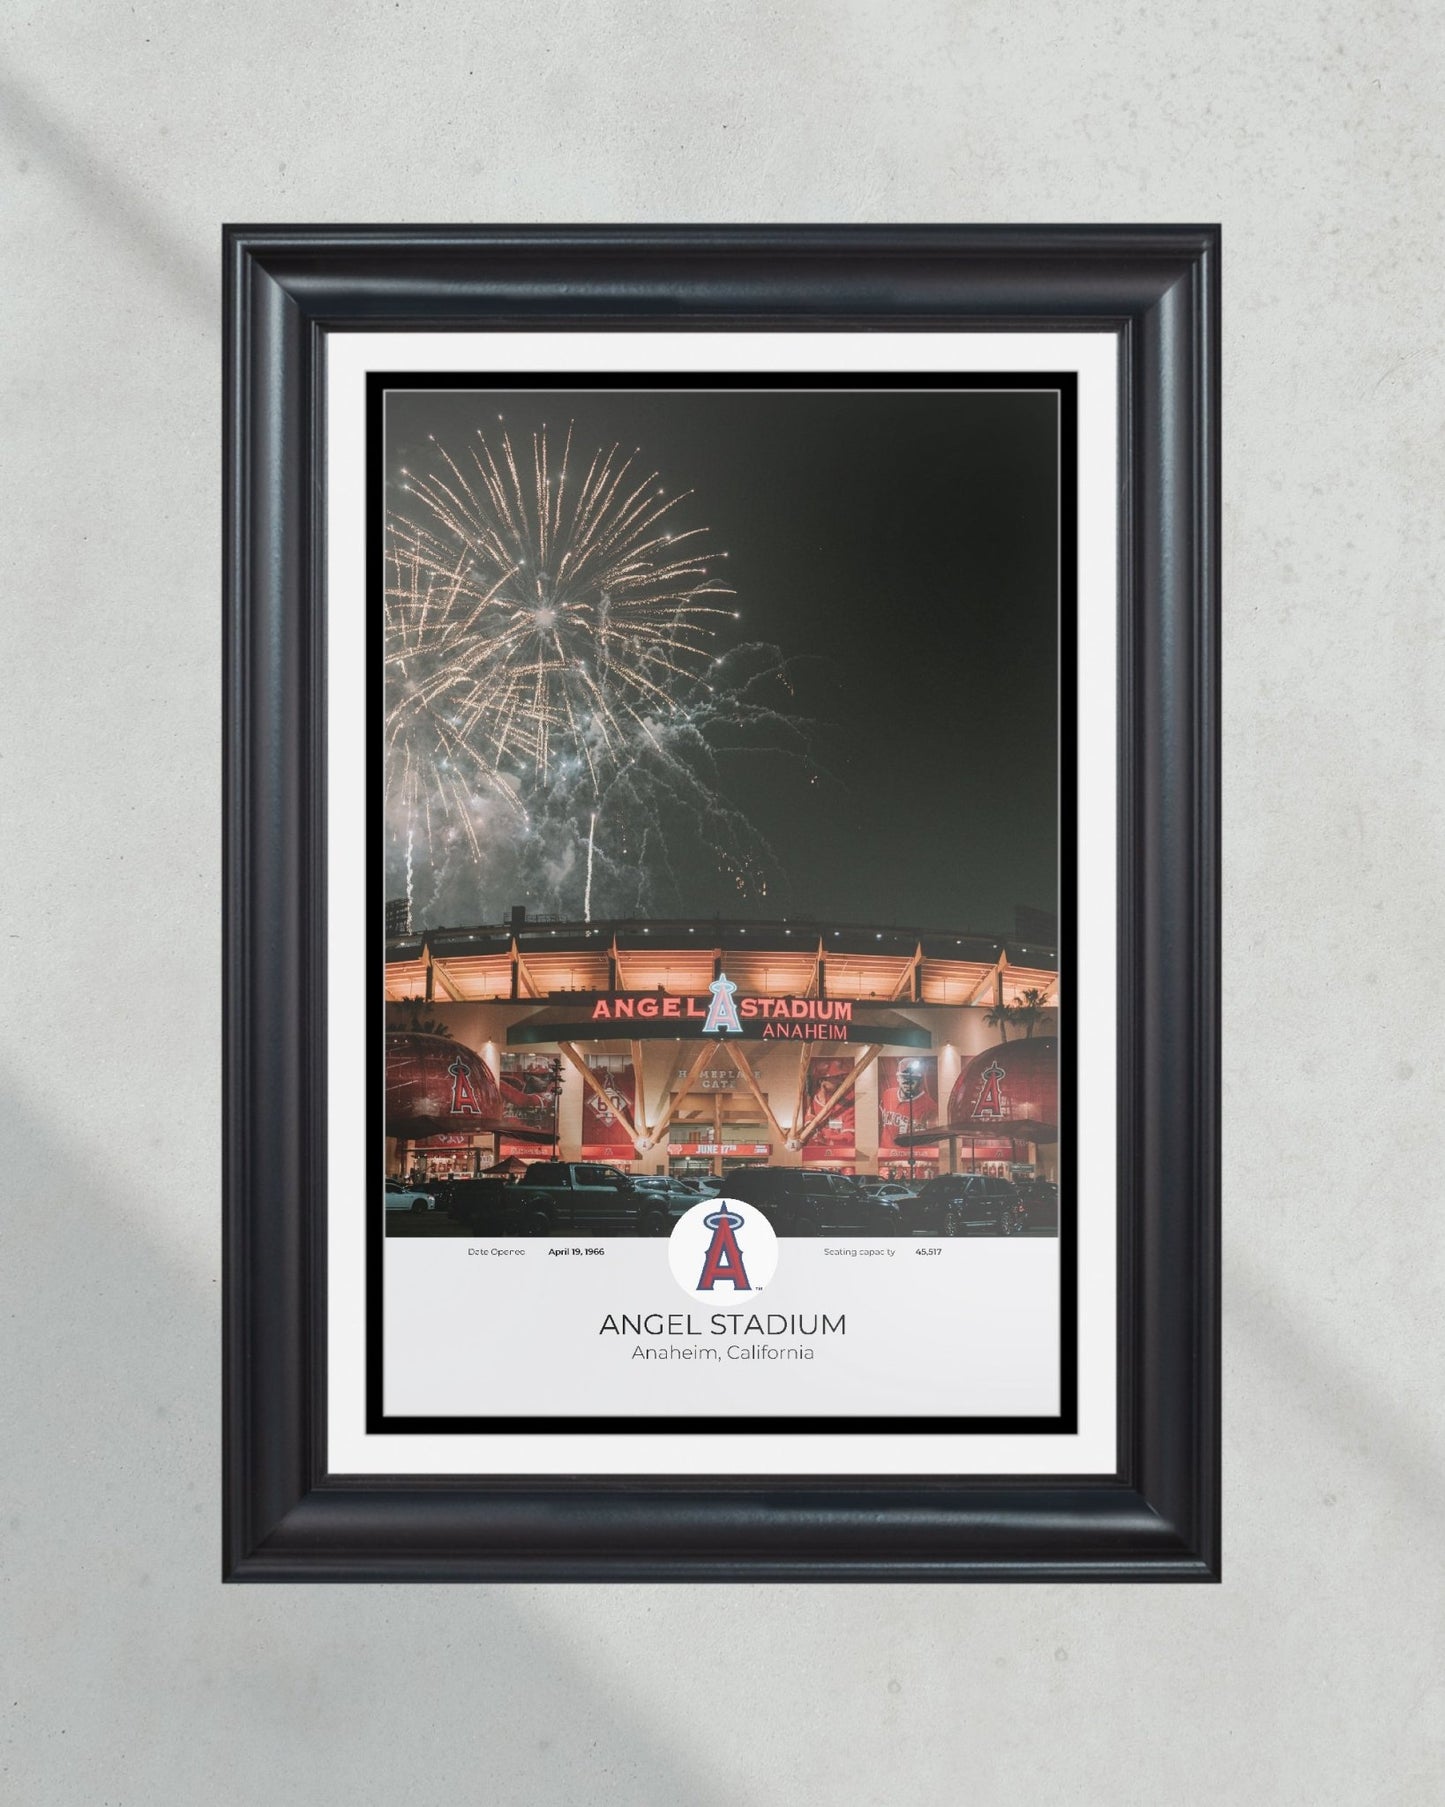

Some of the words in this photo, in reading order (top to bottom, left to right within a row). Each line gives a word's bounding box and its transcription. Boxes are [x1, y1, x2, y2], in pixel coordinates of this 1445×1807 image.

[592, 997, 706, 1019] ANGEL
[740, 998, 852, 1021] STADIUM
[762, 1023, 847, 1040] ANAHEIM
[678, 1070, 761, 1079] HMEPLAE
[696, 1144, 718, 1155] JUNE
[547, 1247, 570, 1257] April
[571, 1247, 584, 1257] 19,
[584, 1247, 605, 1256] 1966
[823, 1247, 858, 1258] Seating
[915, 1247, 943, 1256] 45,517
[599, 1313, 703, 1336] ANGEL
[710, 1313, 846, 1336] STADIUM
[631, 1344, 722, 1362] Anaheim,
[726, 1344, 814, 1360] California
